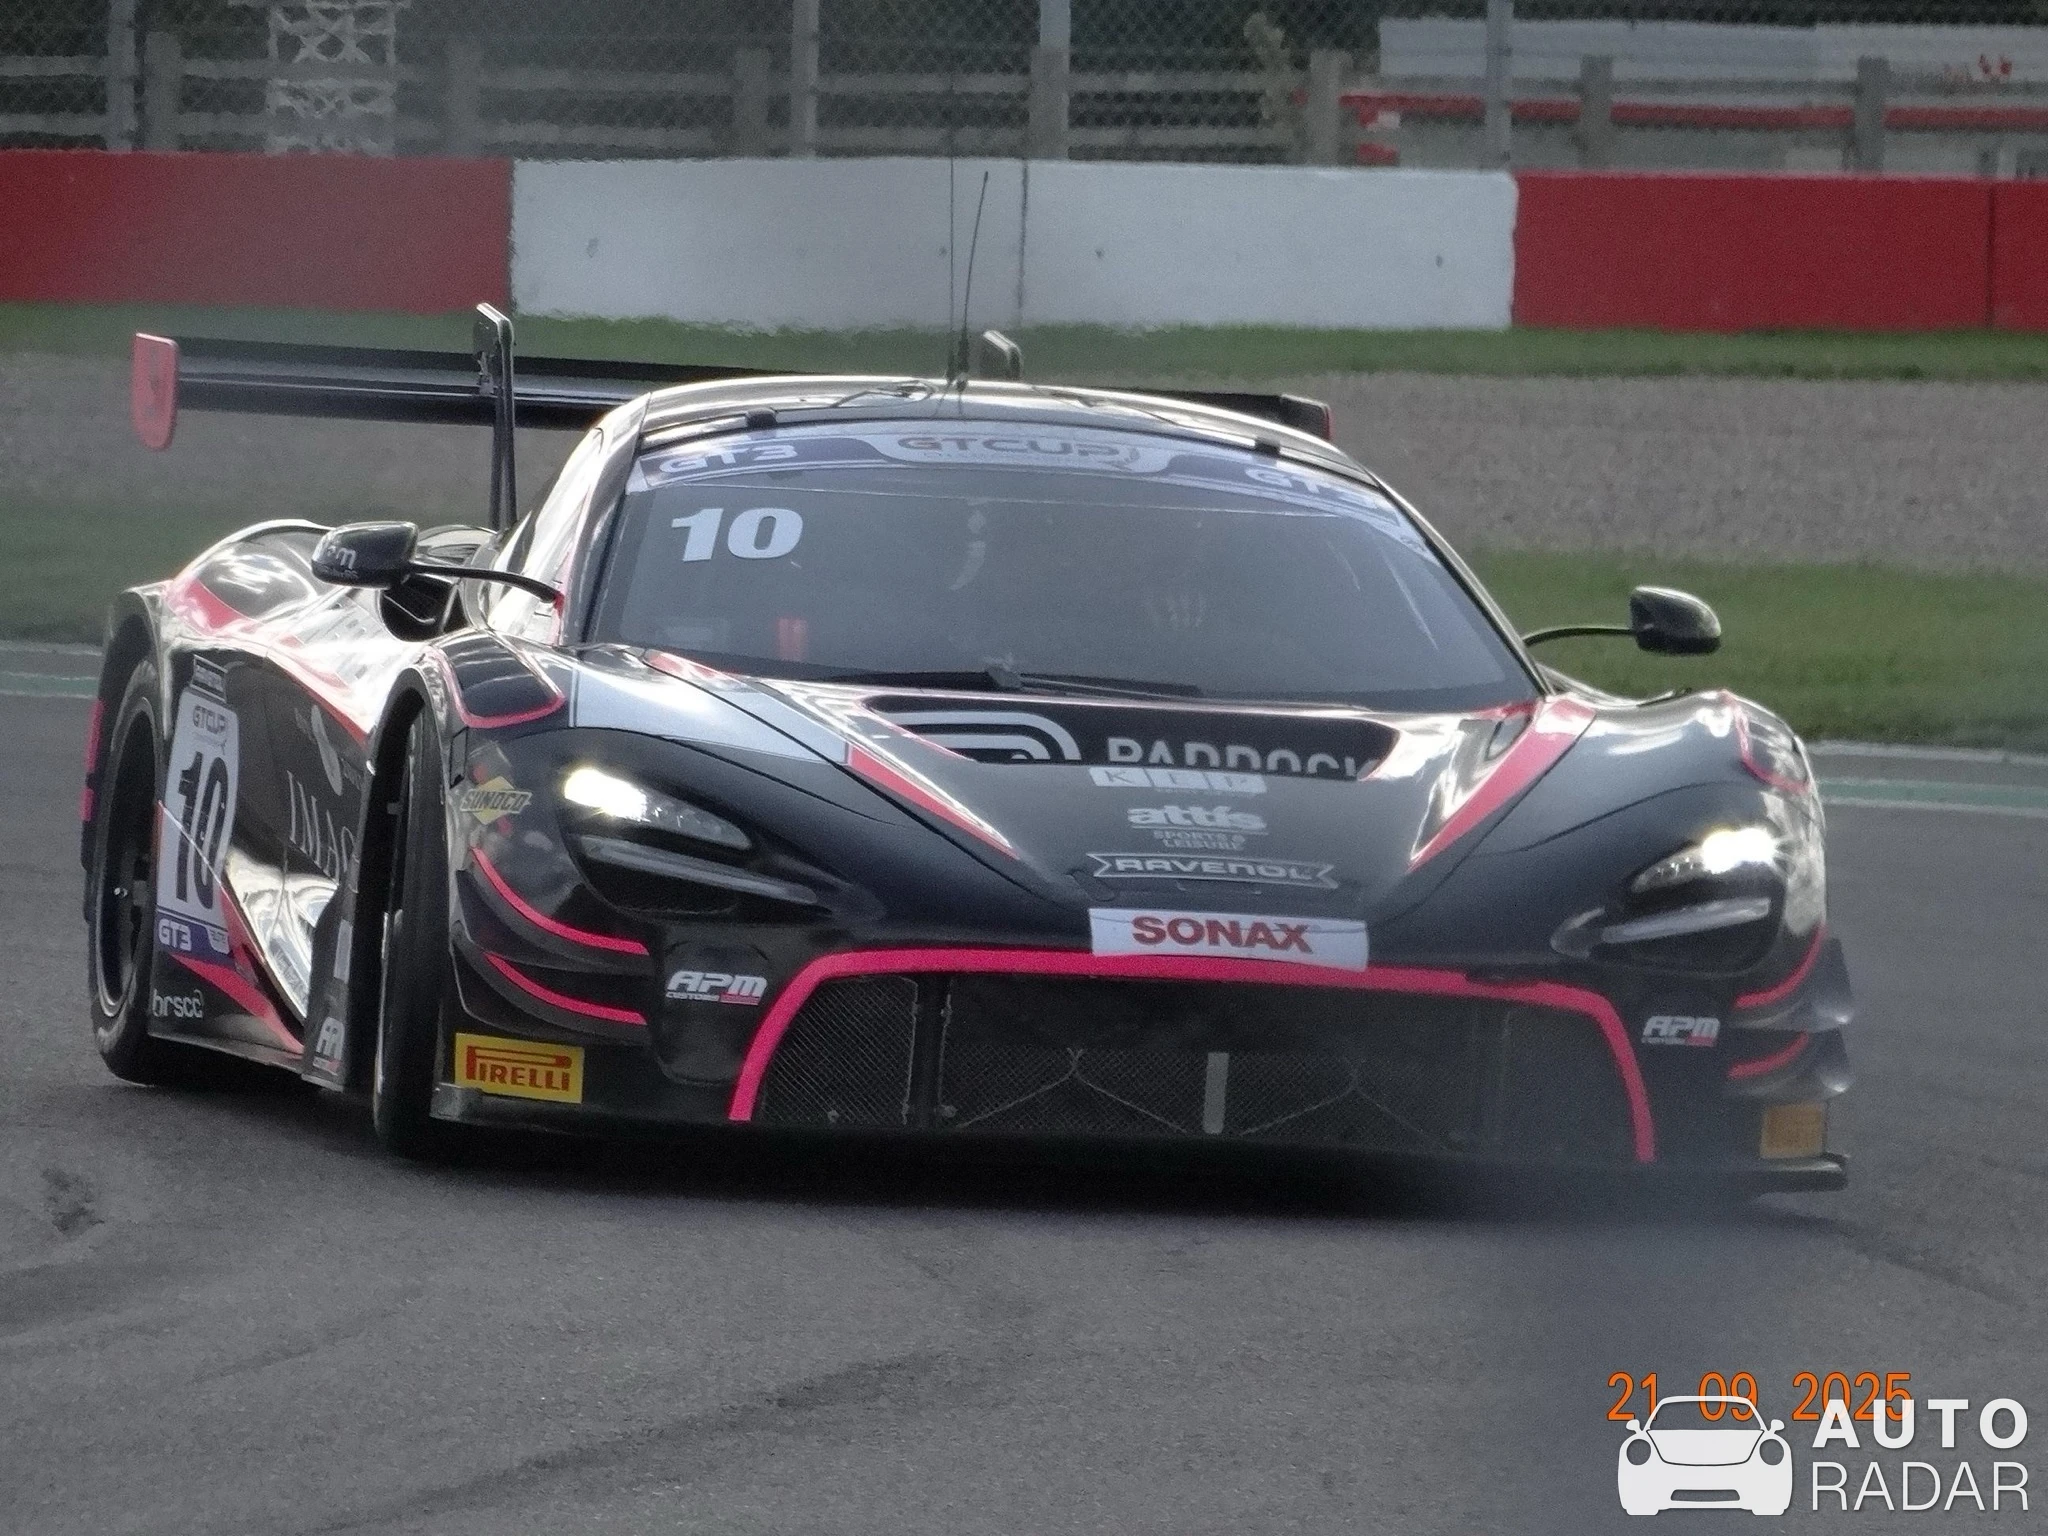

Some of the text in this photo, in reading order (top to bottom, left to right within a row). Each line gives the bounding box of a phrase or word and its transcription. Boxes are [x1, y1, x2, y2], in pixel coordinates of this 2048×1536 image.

[658, 444, 799, 474] GT3
[670, 507, 804, 562] 10
[176, 751, 229, 909] 10
[1114, 858, 1314, 881] RAVENOL
[158, 918, 193, 951] GT3
[1131, 916, 1313, 953] SONAX
[667, 970, 768, 998] APM
[1642, 1015, 1721, 1038] APM
[465, 1045, 573, 1092] PIRELLI
